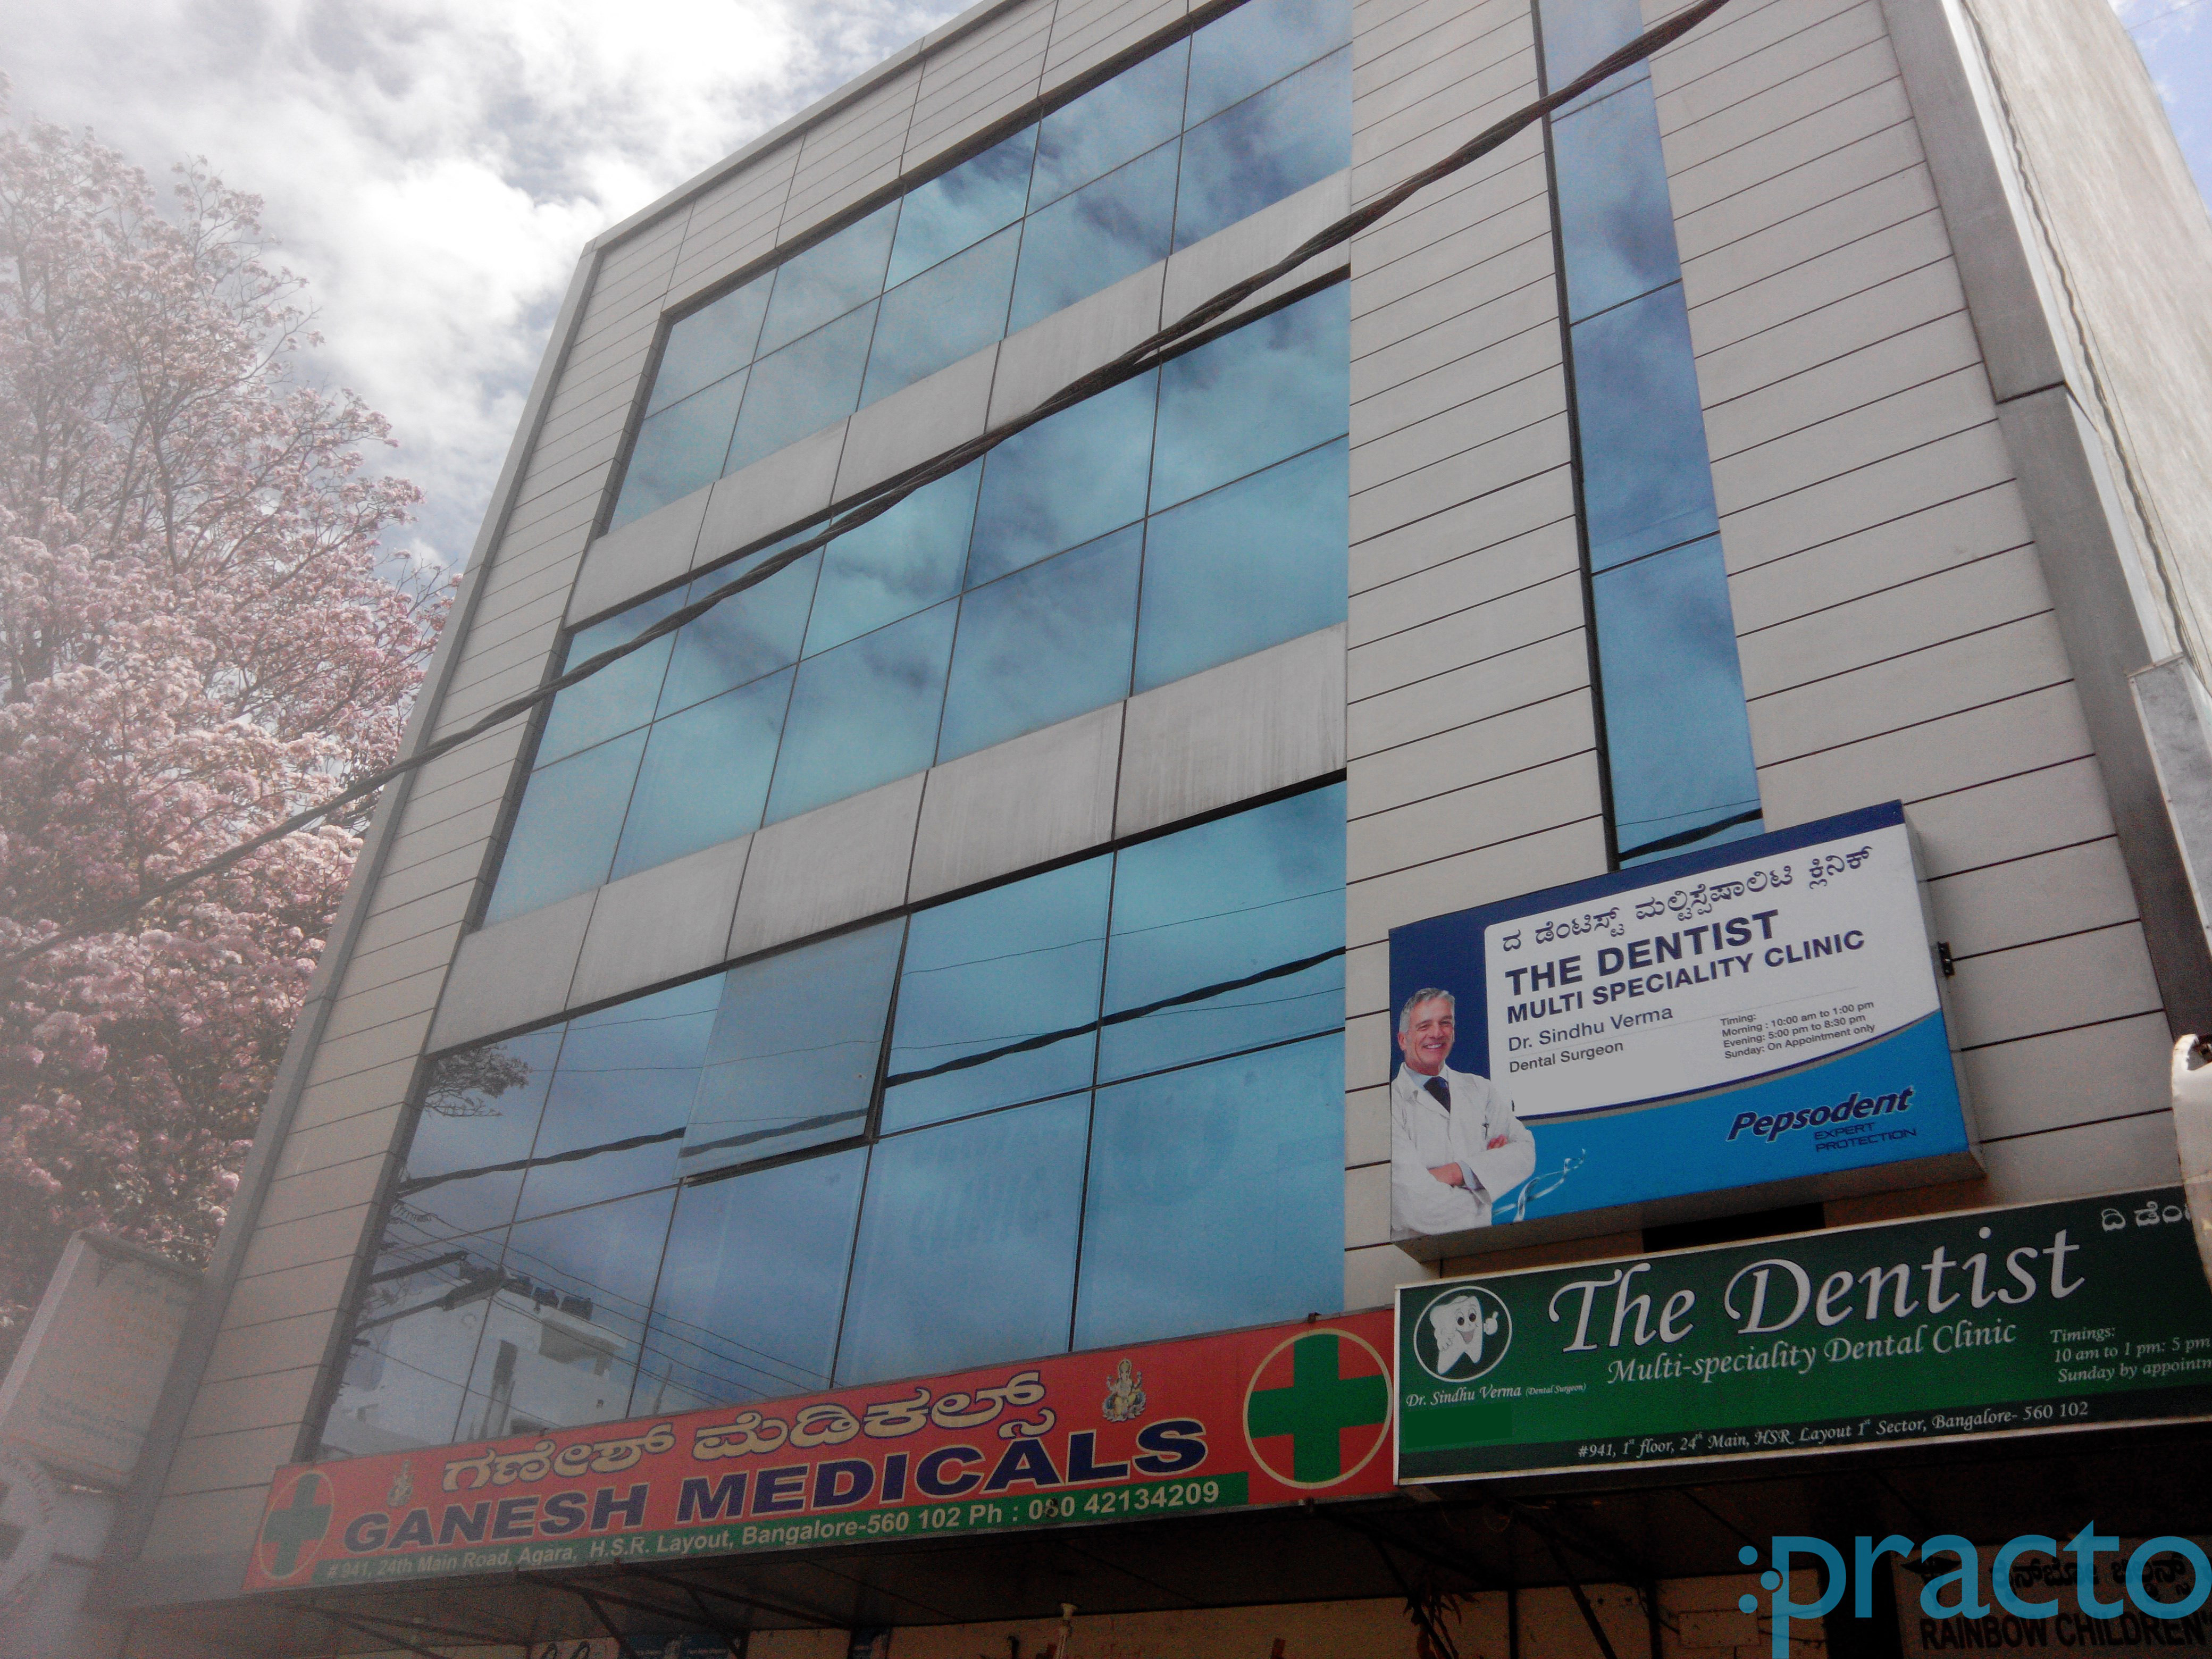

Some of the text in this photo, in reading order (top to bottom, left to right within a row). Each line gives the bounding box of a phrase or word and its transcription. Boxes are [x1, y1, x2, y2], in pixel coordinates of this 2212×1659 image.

[1502, 929, 1521, 952] ದ
[1535, 907, 1625, 944] ಡೆಂಟಿಸ್ಟ್
[1809, 845, 1873, 890] ಕ್ಲಿನಿಕ್
[1505, 909, 1779, 996] THE DENTIST
[1507, 929, 1865, 1024] MULTI SPECIALITY CLINIC
[1509, 1007, 1674, 1052] Dr. Sindhu Verma
[1720, 1013, 1757, 1027] Timing:
[1721, 1023, 1763, 1037] Morning
[1771, 1015, 1798, 1028] 10:00
[1801, 1013, 1817, 1021] am
[1819, 1009, 1830, 1018] to
[1832, 1003, 1855, 1015] 1:00
[1857, 1001, 1875, 1012] pm
[1723, 1014, 1866, 1048] Evening: 5:00 pm to 8:30 pm
[1509, 1042, 1624, 1073] Dental Surgeon
[1724, 1023, 1876, 1060] Sunday: On Appointment only
[1725, 1085, 1914, 1143] Pepsodent
[1814, 1121, 1875, 1140] EXPERT
[1815, 1128, 1917, 1153] PROTECTION
[1548, 1226, 2085, 1353] The Dentist
[1607, 1318, 2017, 1385] Multi-speciality Dental Clinic
[2050, 1327, 2116, 1344] Timings:
[2055, 1348, 2072, 1363] 10
[2076, 1348, 2100, 1361] am
[2104, 1345, 2119, 1358] to
[2125, 1342, 2131, 1356] 1
[2172, 1337, 2181, 1352] 5
[2184, 1337, 2211, 1354] pm
[2057, 1365, 2116, 1383] Sunday
[2119, 1362, 2138, 1379] by
[1405, 1382, 1587, 1407] Dr. Sindhu Verma (Dental Surgeon)
[441, 1368, 1057, 1493] ಗಣೇಶ್ ಮೆಡಿಕಲ್ಸ್
[1578, 1442, 1616, 1459] #941,
[1636, 1437, 1675, 1459] floor,
[1707, 1431, 1750, 1449] Main,
[1754, 1428, 1794, 1446] HSR
[1798, 1426, 1853, 1446] Layout
[1876, 1414, 1927, 1436] Sector,
[1931, 1407, 2018, 1432] Bangalore-
[2022, 1404, 2054, 1421] 560
[2059, 1401, 2089, 1417] 102
[342, 1417, 1209, 1554] GANESH MEDICALS
[378, 1557, 413, 1576] 24th
[417, 1554, 457, 1573] Main
[518, 1545, 577, 1567] Agara,
[590, 1537, 651, 1559] H.S.R.
[656, 1529, 734, 1555] Layout,
[741, 1510, 909, 1546] Bangalore-560
[918, 1507, 961, 1530] 102
[968, 1502, 1003, 1526] Ph
[1028, 1496, 1075, 1521] 080
[1084, 1480, 1220, 1514] 42134209
[1920, 1614, 2048, 1650] RAINBOW
